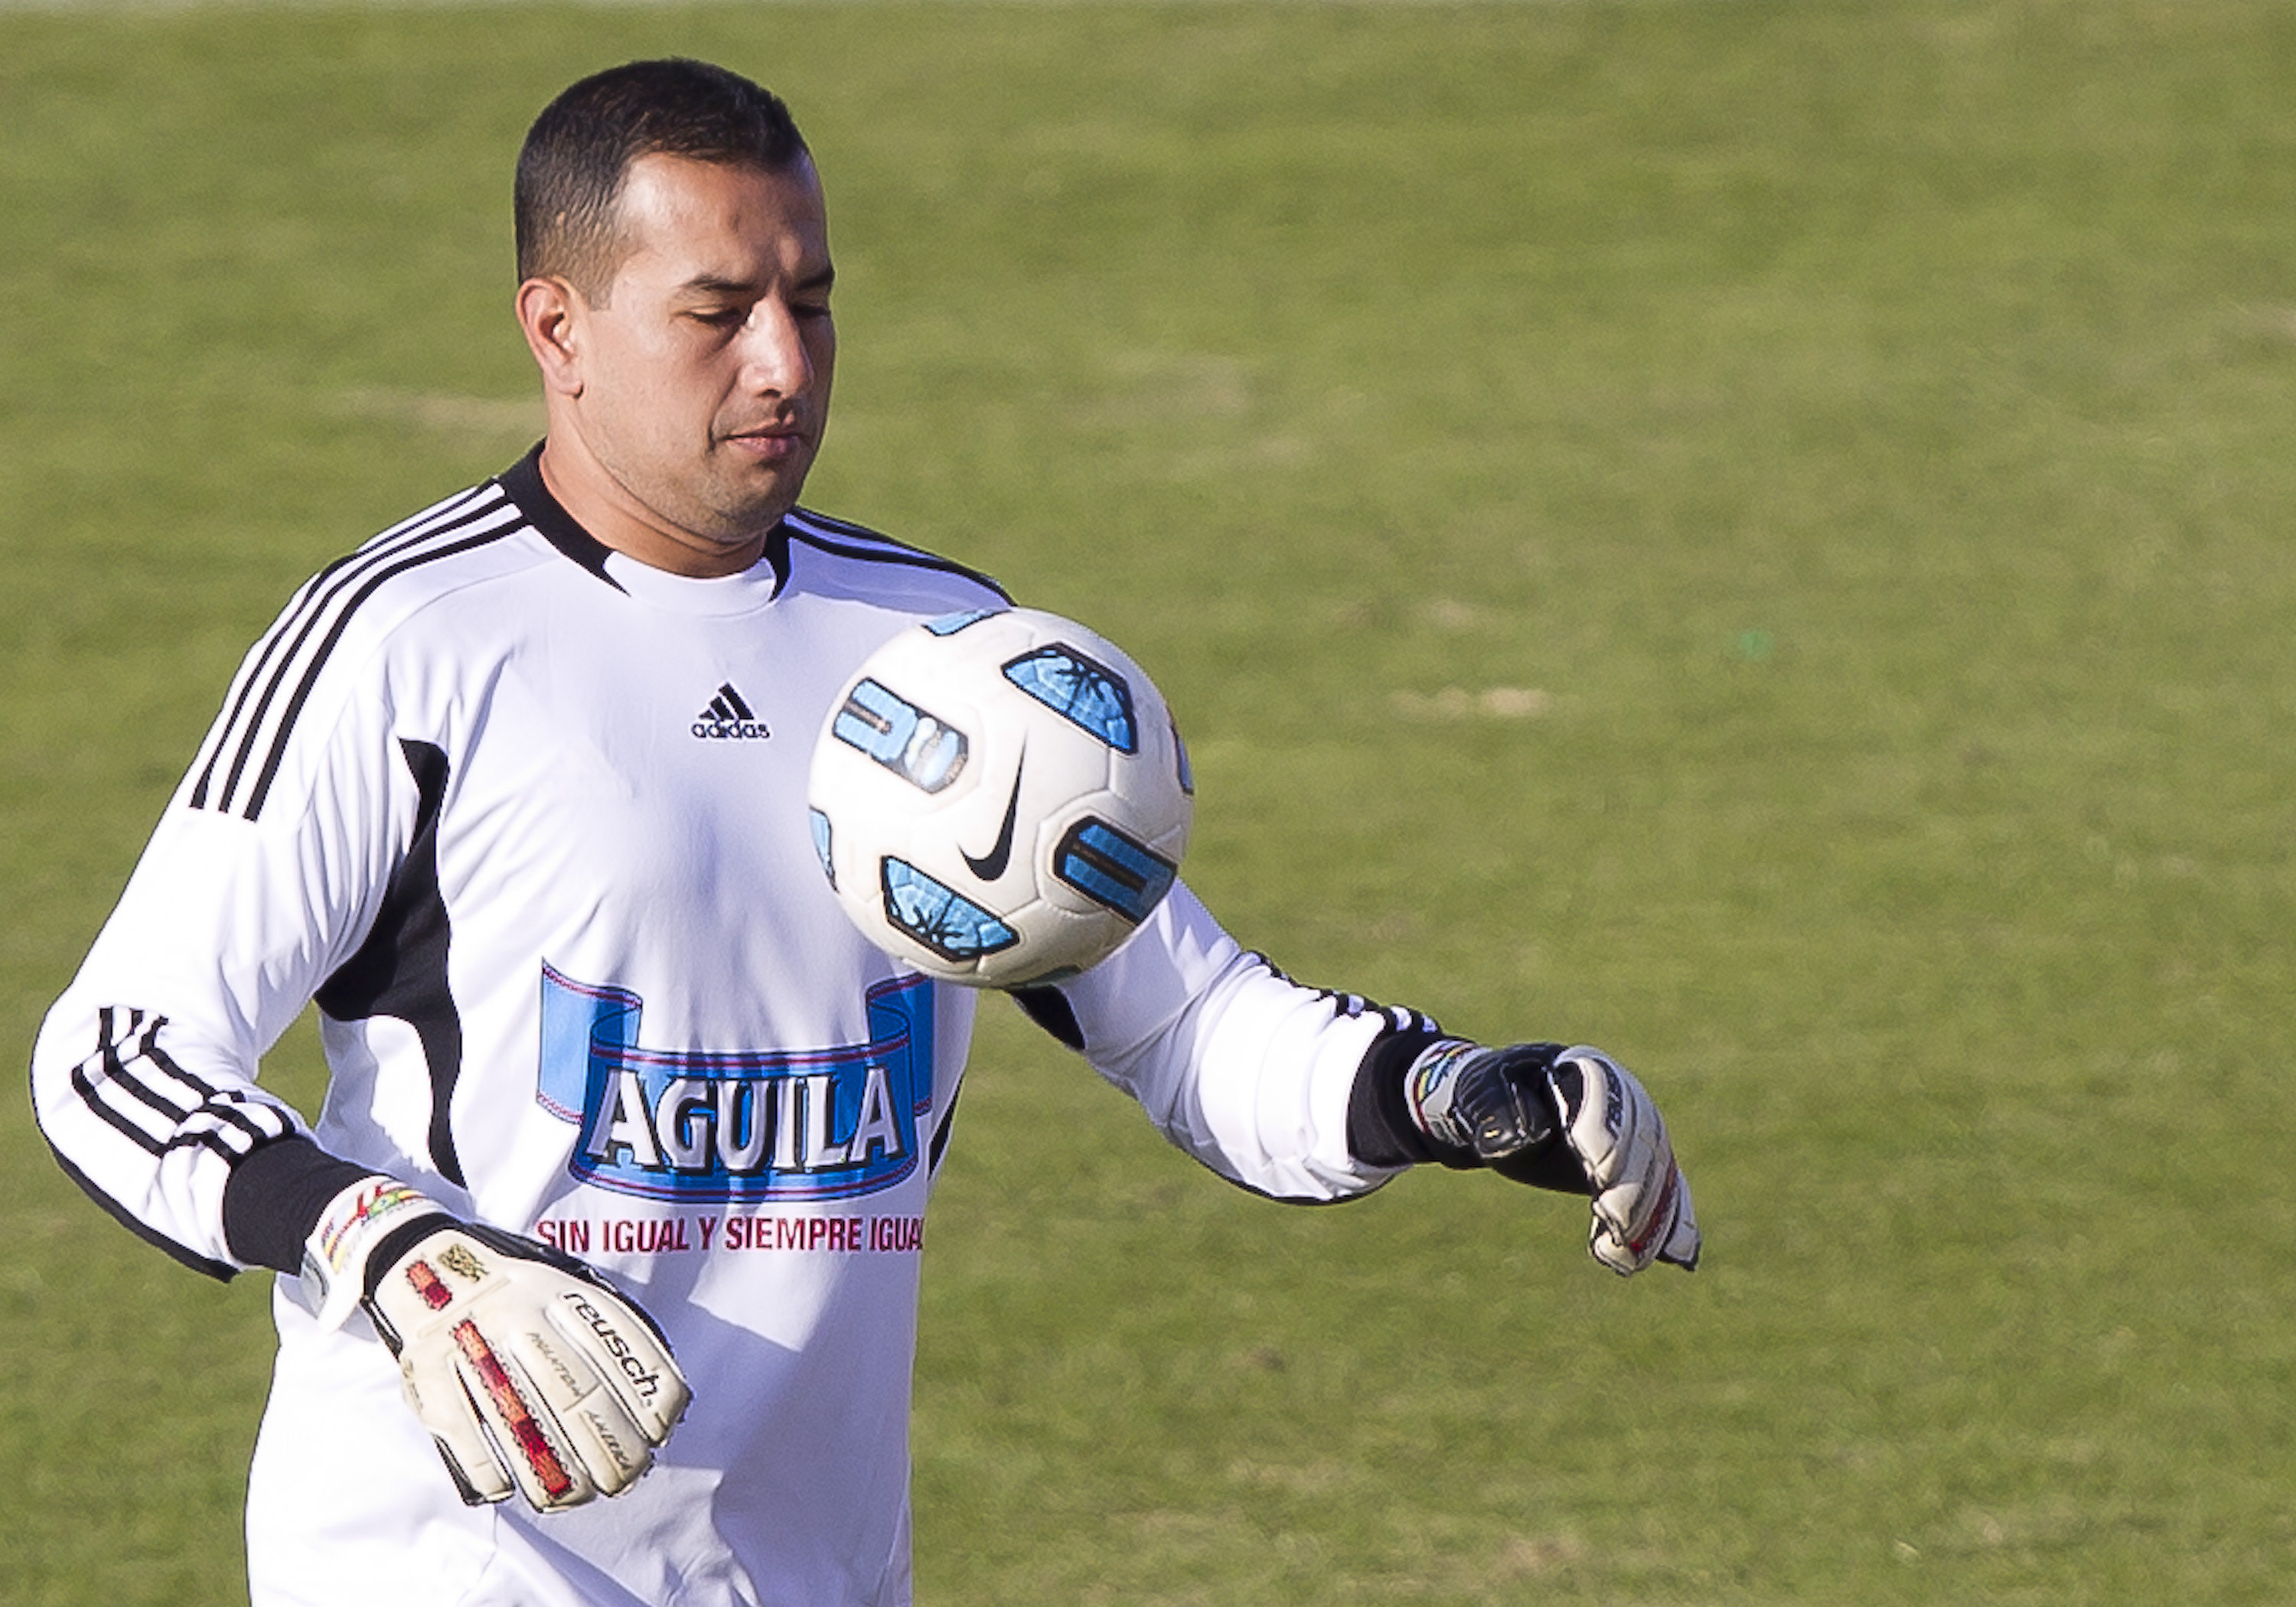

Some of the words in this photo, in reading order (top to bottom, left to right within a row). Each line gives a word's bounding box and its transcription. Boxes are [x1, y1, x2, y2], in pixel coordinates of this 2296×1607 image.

[691, 720, 770, 738] adidas
[586, 1068, 900, 1172] AGUILA
[537, 1219, 589, 1253] SIN
[602, 1217, 689, 1253] IGUAL
[698, 1217, 717, 1250] Y
[726, 1216, 862, 1251] SIEMPRE
[869, 1217, 924, 1251] IGUA
[563, 1293, 659, 1397] reusch
